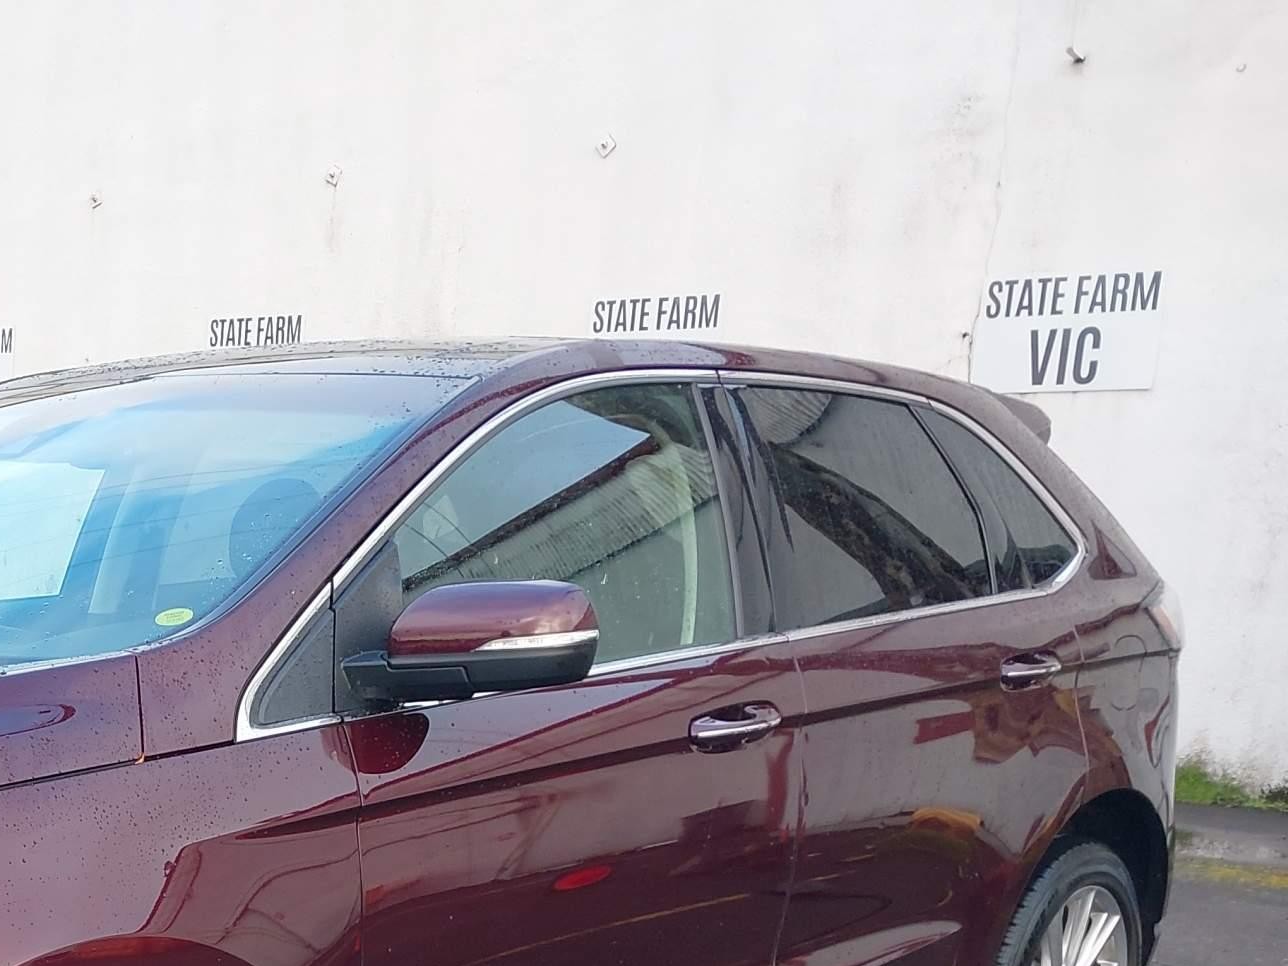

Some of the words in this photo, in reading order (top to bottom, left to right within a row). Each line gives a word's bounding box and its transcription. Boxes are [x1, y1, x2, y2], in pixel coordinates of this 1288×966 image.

[592, 298, 652, 334] STATE
[655, 294, 721, 331] FARM
[986, 277, 1068, 319] STATE
[1073, 271, 1162, 315] FARM
[209, 318, 253, 347] STATE
[256, 314, 302, 346] FARM
[1030, 326, 1102, 386] VIC
